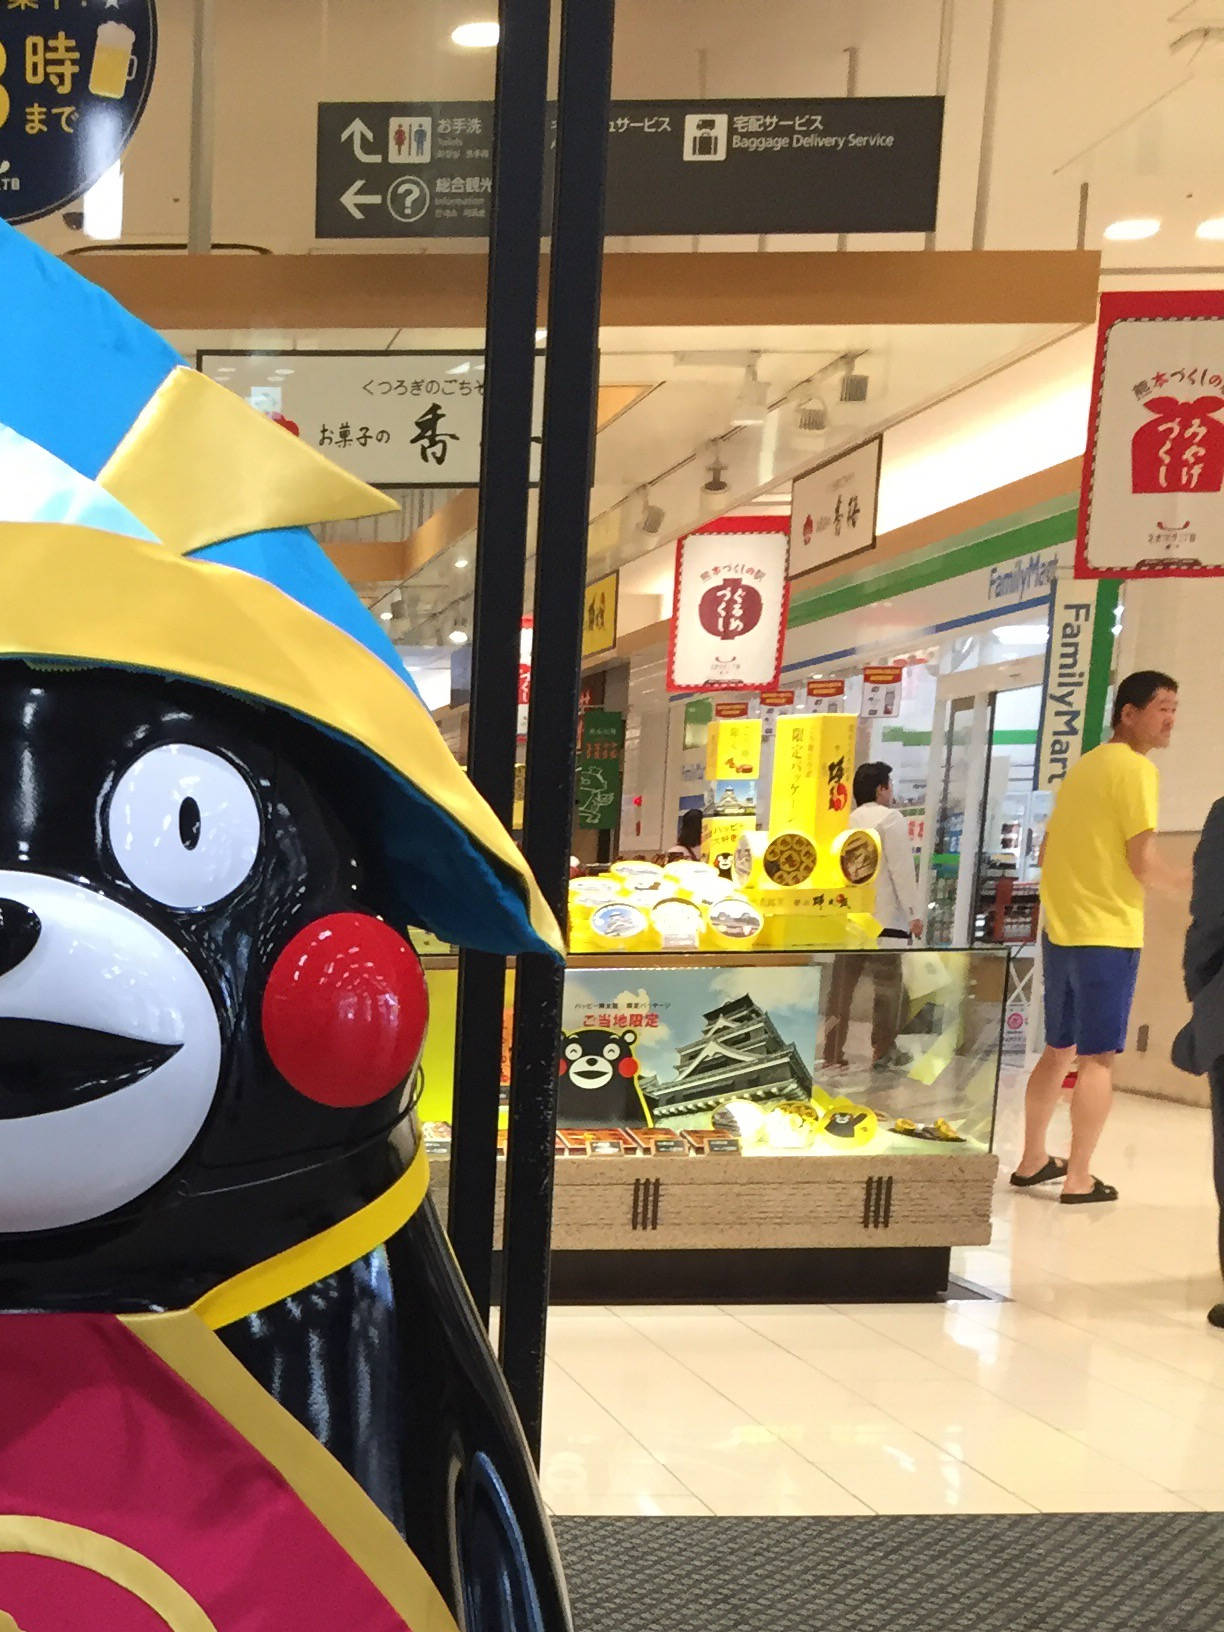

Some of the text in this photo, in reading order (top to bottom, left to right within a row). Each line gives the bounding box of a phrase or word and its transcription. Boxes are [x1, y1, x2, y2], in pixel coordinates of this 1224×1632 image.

[25, 103, 78, 135] まで
[733, 115, 823, 132] 宅配サービス
[732, 133, 894, 151] Baggage Delivery Service
[1132, 368, 1224, 400] 熊本づくしの
[1157, 417, 1181, 488] づくし
[716, 587, 731, 631] づくし
[1047, 603, 1091, 784] FamilyMart
[584, 1014, 659, 1027] ご当地限定
